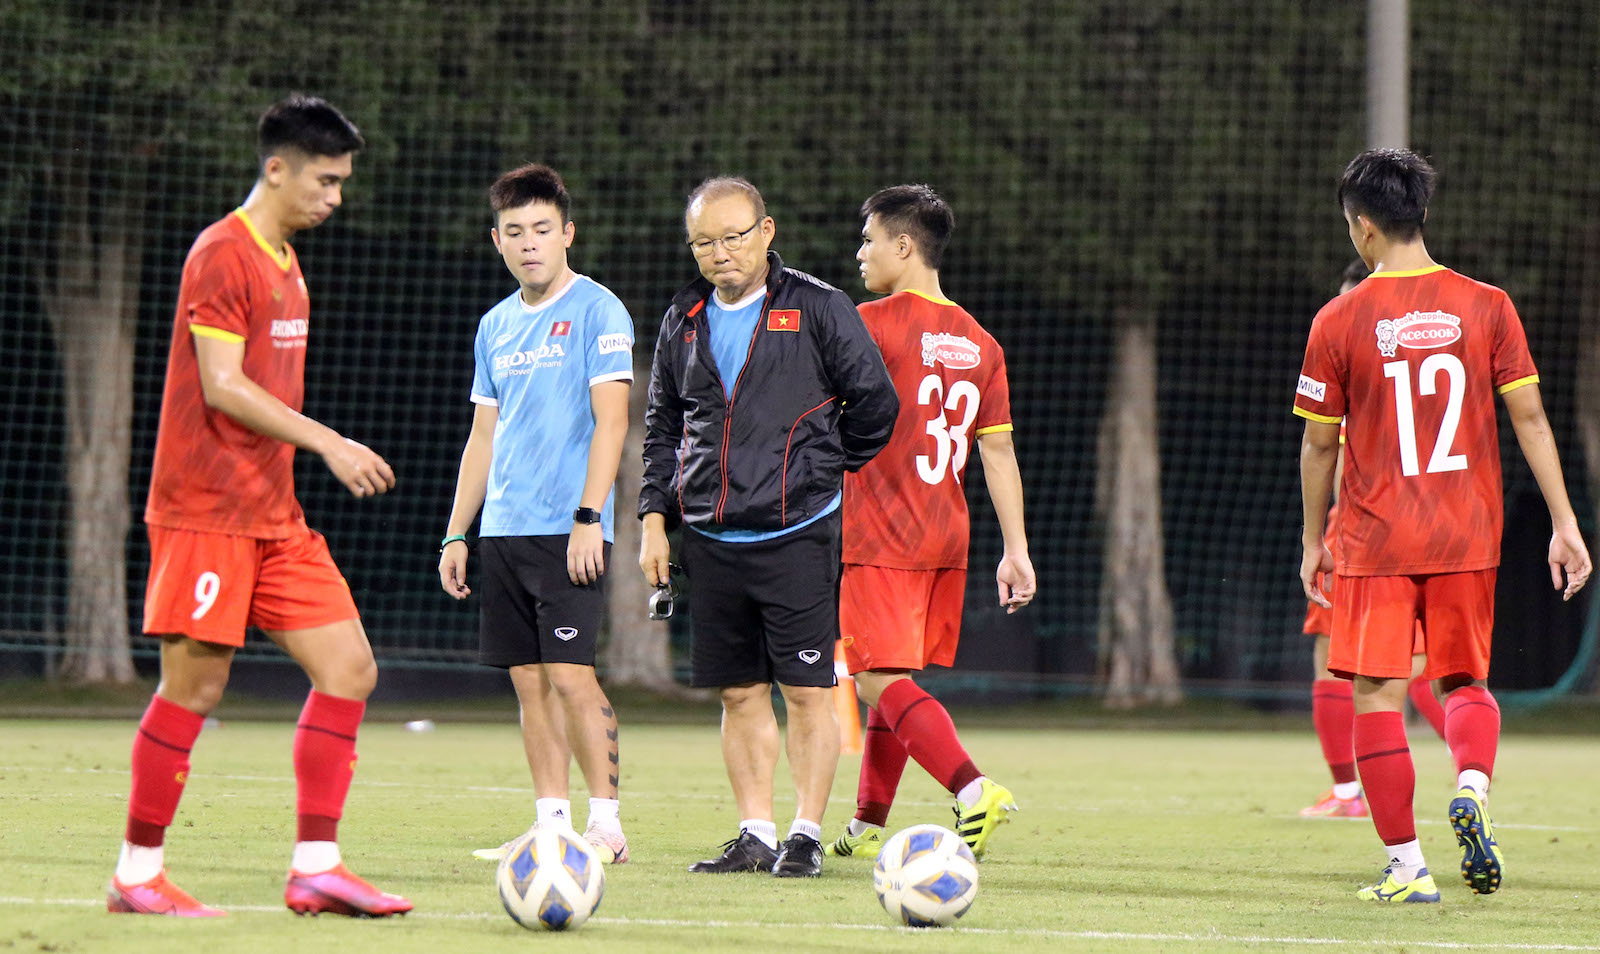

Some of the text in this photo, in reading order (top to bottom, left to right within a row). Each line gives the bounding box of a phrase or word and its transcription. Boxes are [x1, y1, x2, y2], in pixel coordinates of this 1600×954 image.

[1394, 311, 1459, 328] Cook happiness
[495, 343, 566, 370] HONDA
[600, 337, 630, 349] VINA
[1299, 380, 1323, 397] MILK
[1382, 353, 1468, 477] 12
[915, 374, 980, 485] 33
[191, 571, 220, 620] 9
